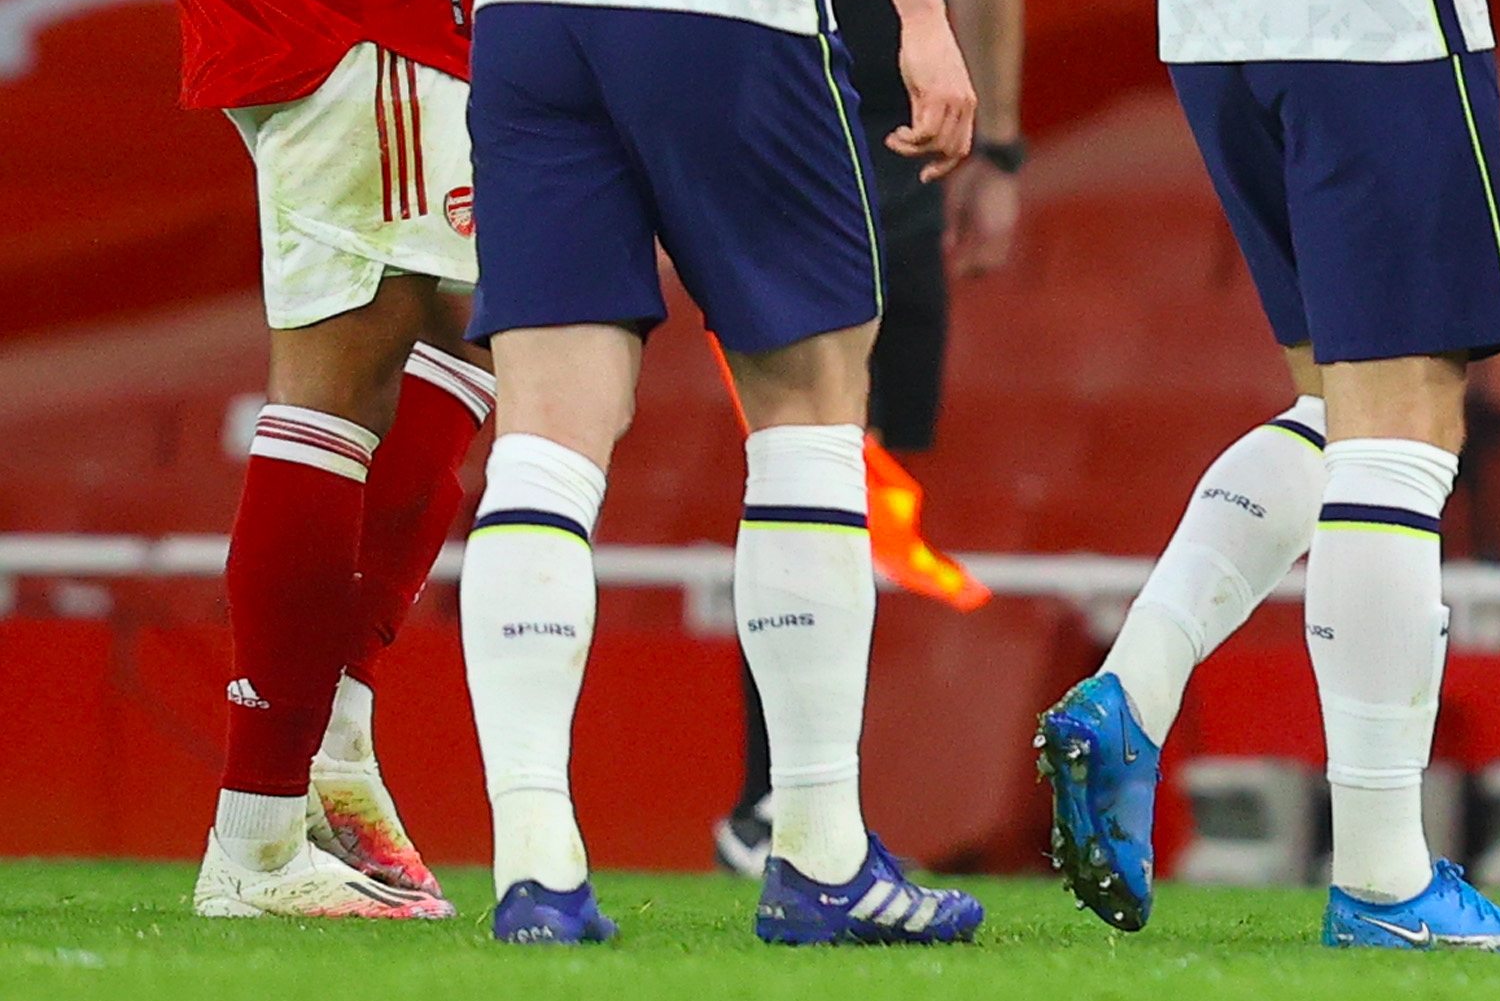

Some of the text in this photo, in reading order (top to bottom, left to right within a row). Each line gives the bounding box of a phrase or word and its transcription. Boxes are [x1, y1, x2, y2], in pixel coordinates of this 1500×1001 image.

[1200, 488, 1267, 519] SPURS
[502, 622, 576, 638] SPURS
[748, 612, 815, 632] SPURS
